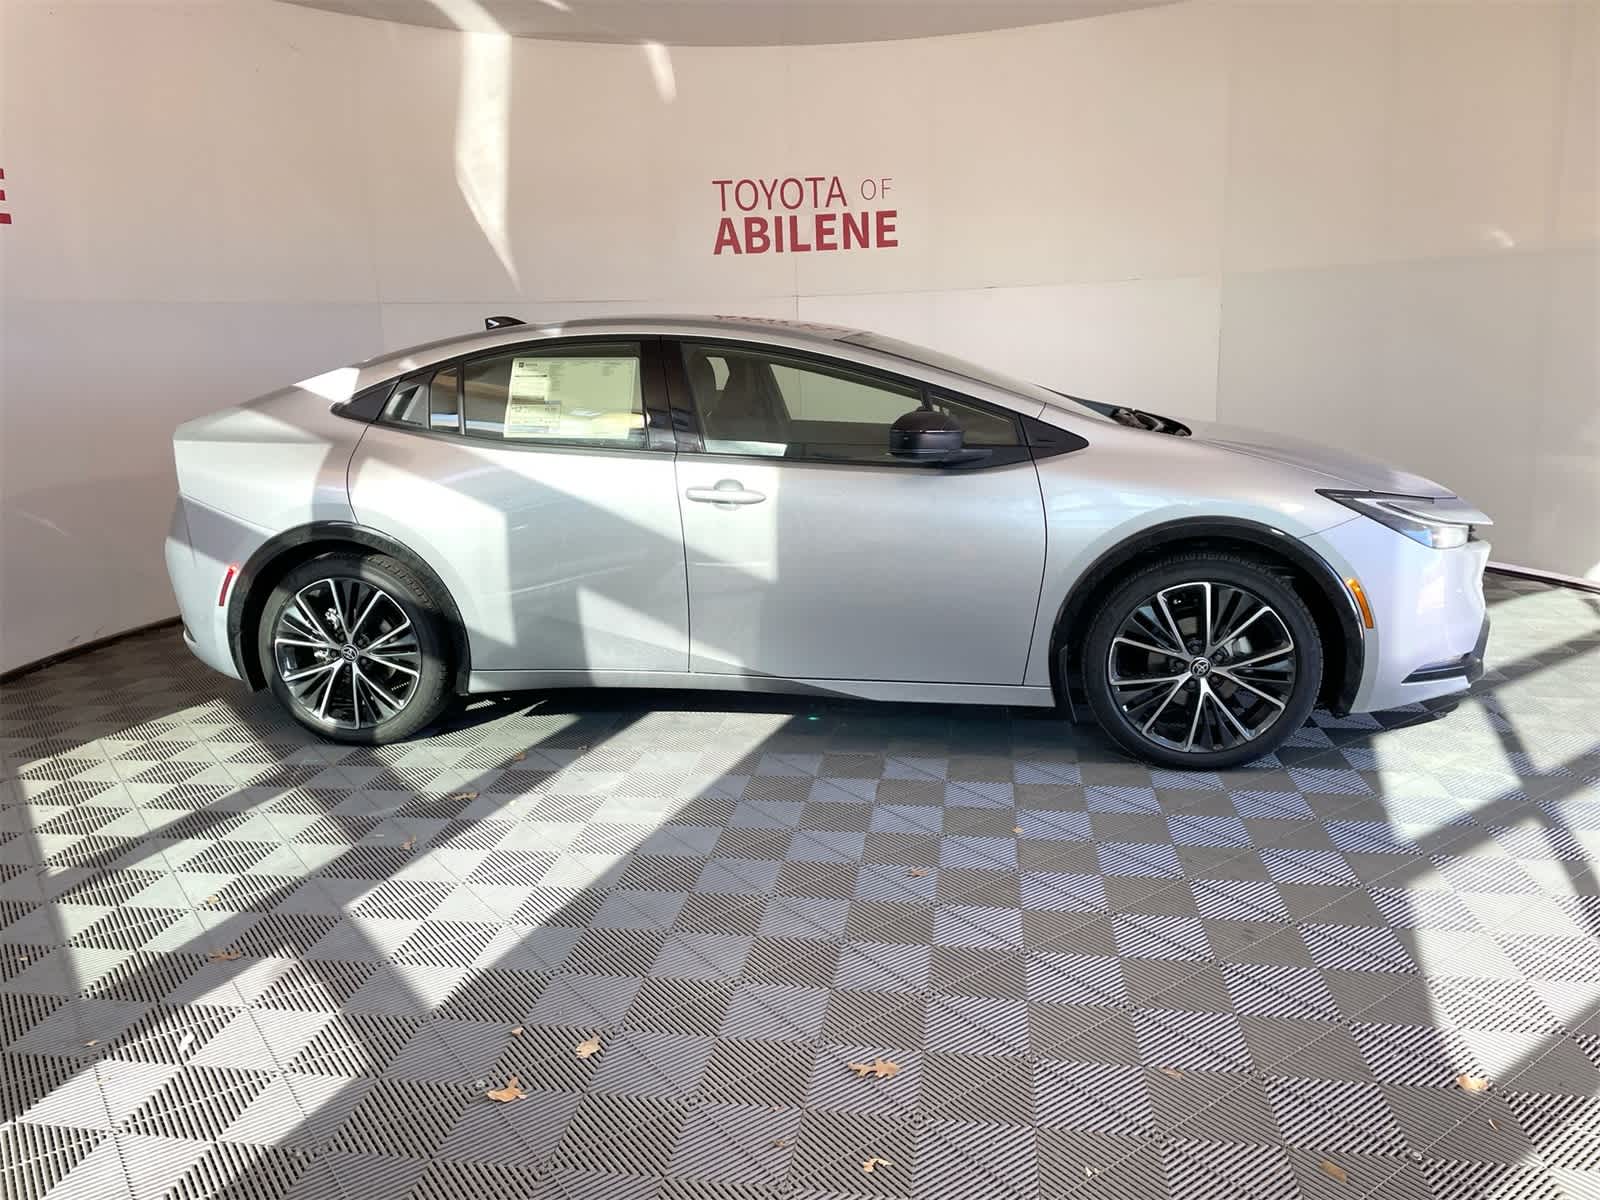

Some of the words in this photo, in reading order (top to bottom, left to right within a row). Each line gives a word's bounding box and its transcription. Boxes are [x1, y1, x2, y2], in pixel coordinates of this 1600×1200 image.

[712, 176, 848, 212] TOYOTA
[860, 178, 893, 200] OF
[713, 210, 898, 255] ABILENE
